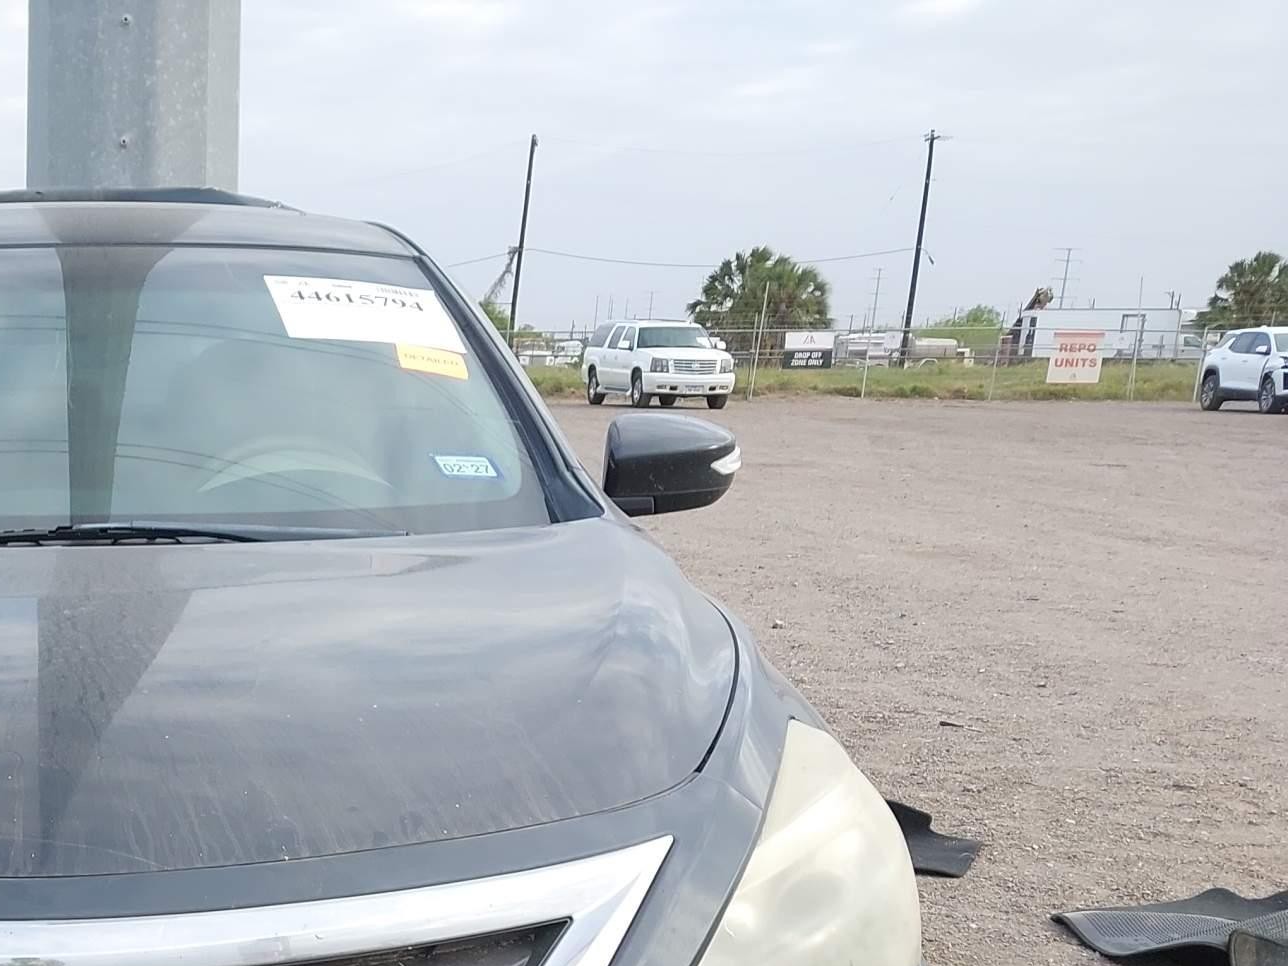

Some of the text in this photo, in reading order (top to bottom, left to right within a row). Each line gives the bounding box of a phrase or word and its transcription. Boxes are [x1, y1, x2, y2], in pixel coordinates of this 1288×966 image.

[290, 290, 424, 312] 44615794
[1059, 342, 1097, 353] REPO
[794, 351, 811, 359] DROP
[790, 359, 824, 367] ZONE ONLY
[1054, 357, 1097, 368] UNITS
